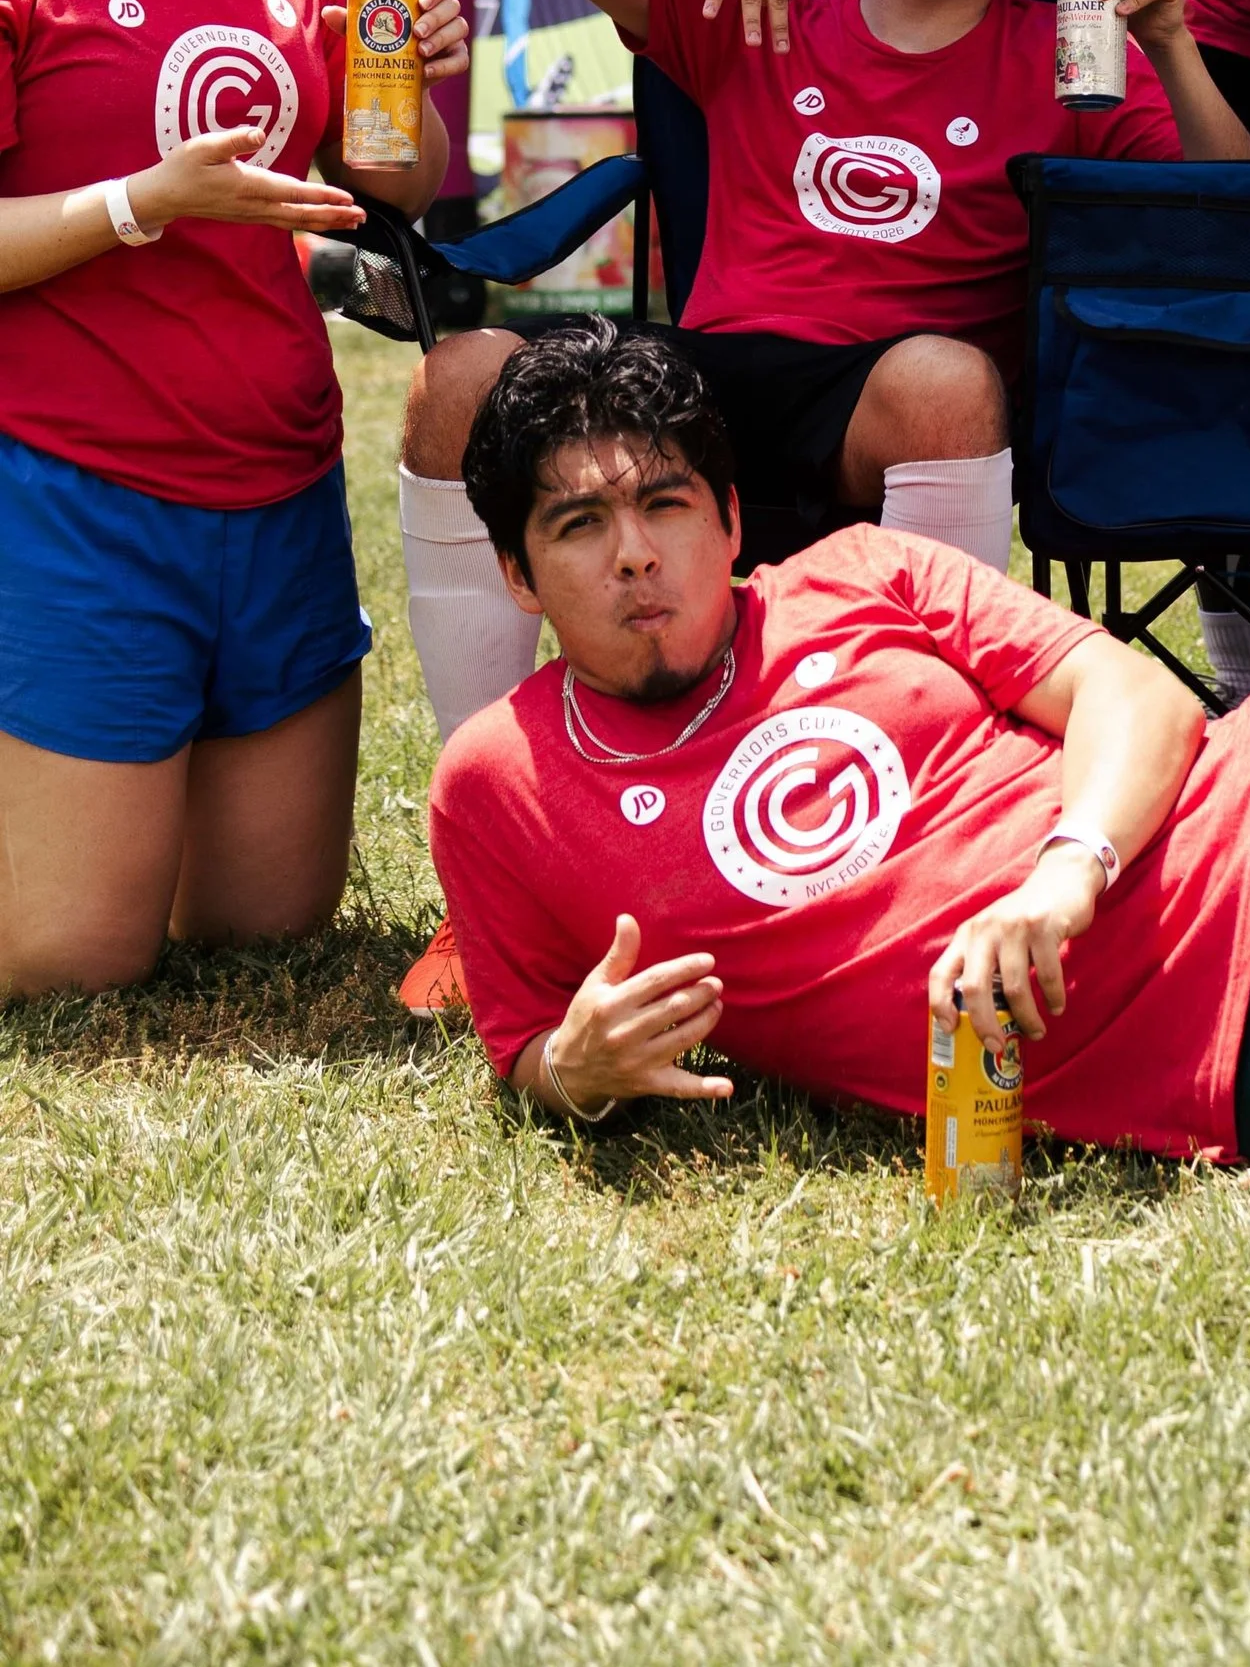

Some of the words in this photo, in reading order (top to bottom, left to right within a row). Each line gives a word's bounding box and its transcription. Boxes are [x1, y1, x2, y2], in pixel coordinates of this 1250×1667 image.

[117, 2, 140, 20] JD
[168, 30, 250, 74] GOVERNORS
[258, 43, 286, 74] CUP
[364, 37, 406, 52] MÜNCHEN
[353, 58, 415, 70] PAULANER
[353, 72, 391, 80] MÜNCHNER
[394, 73, 415, 81] LAGER
[796, 93, 822, 109] JD
[813, 212, 832, 227] NYC
[872, 226, 904, 239] 2026
[710, 721, 788, 832] GOVERNORS
[632, 790, 657, 819] JD
[838, 841, 880, 882] FOOTY
